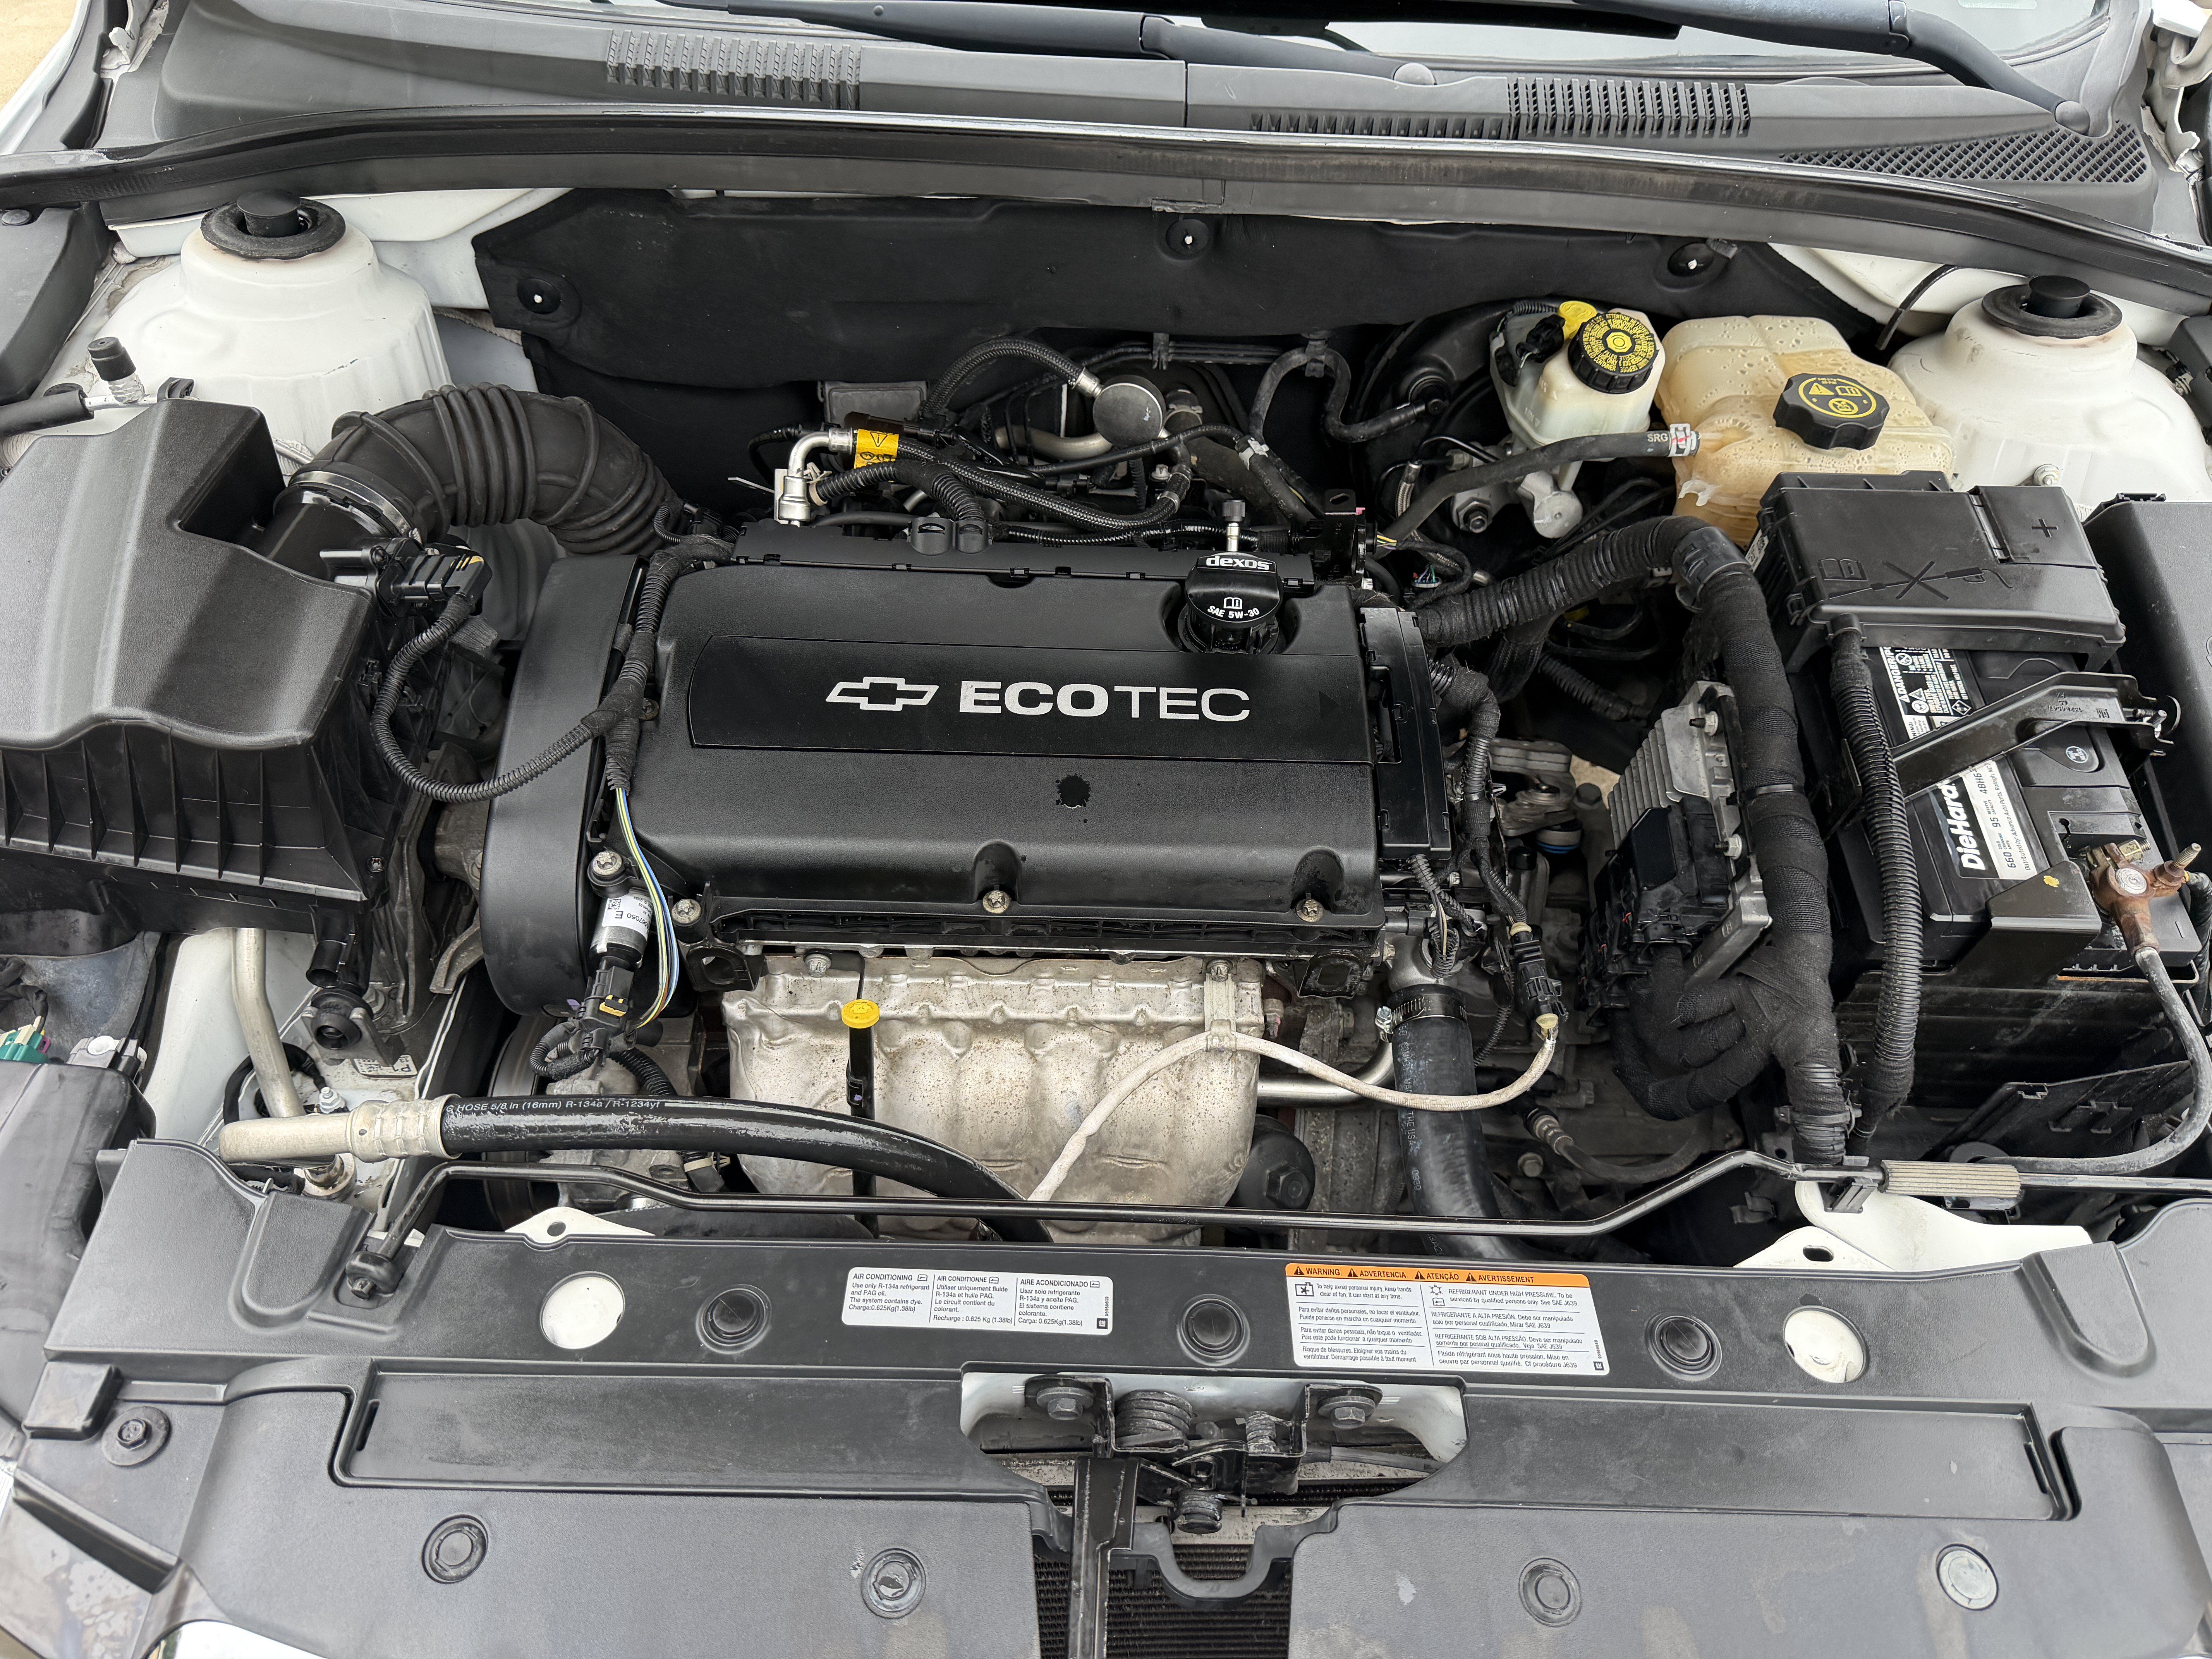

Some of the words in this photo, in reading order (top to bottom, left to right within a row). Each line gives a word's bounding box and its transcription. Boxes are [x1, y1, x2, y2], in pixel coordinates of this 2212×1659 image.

[1647, 433, 1668, 442] SRG
[1206, 556, 1269, 570] dexos
[1207, 605, 1225, 617] SAE
[1228, 608, 1260, 619] 5W-30
[959, 680, 1250, 721] ECOTEC
[1938, 784, 1986, 870] DieHard
[1990, 817, 2001, 828] 95
[2004, 852, 2016, 868] 660
[2019, 847, 2031, 871] Distributed
[615, 910, 623, 919] E
[522, 1101, 561, 1110] (16mm)
[613, 1100, 659, 1109] R-1234yf
[1406, 1111, 1415, 1127] THE
[1407, 1129, 1416, 1146] USA
[1305, 1268, 1340, 1276] WARNING
[1426, 1272, 1459, 1280] ATENÇÃO
[1478, 1274, 1534, 1283] AVERTISSEMENT
[933, 1314, 961, 1322] Recharge
